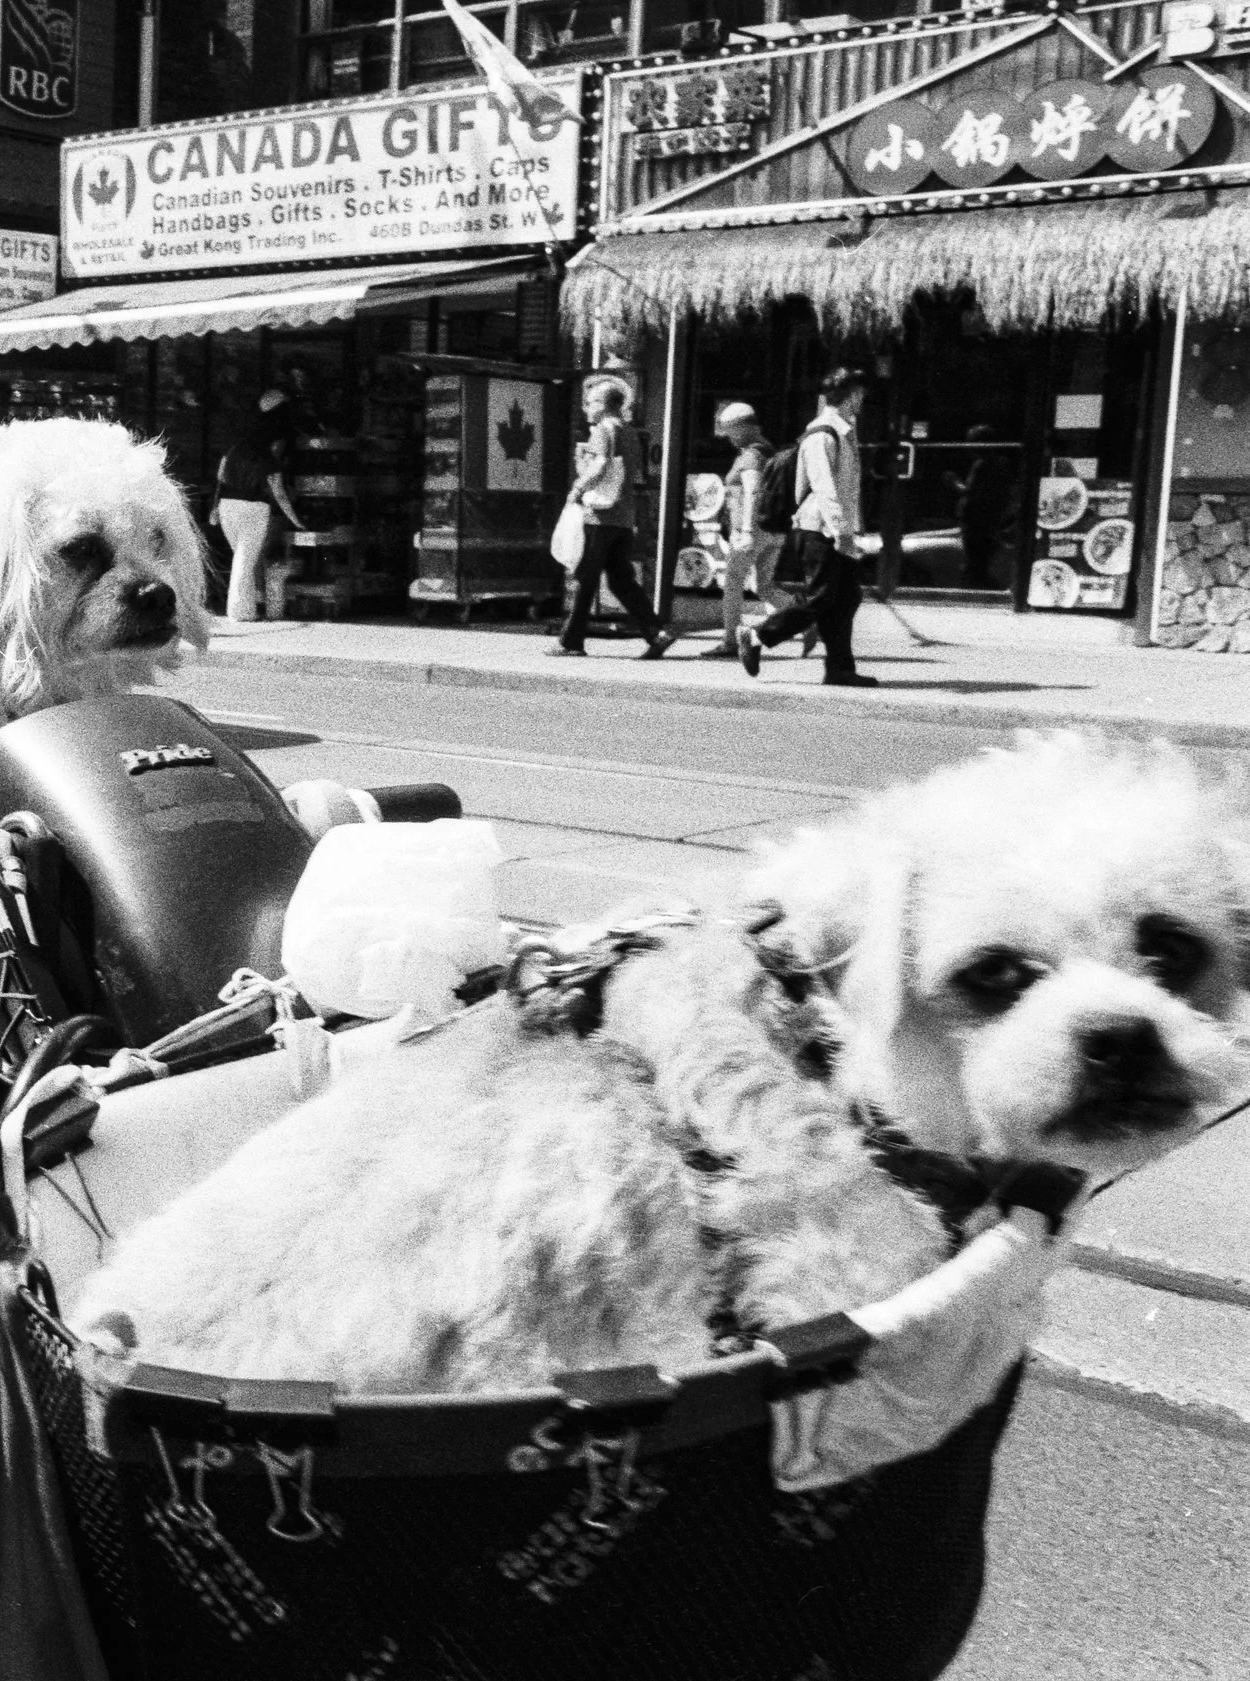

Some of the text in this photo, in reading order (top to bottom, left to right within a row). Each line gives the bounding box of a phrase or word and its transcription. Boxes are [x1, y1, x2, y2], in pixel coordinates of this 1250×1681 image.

[9, 66, 69, 107] RBC
[147, 116, 361, 184] CANADA
[152, 156, 550, 211] Canadian Souvenirs T-Shirts Caps
[152, 183, 550, 235] Handbags Gifts Socks And More
[1, 237, 51, 262] GIFTS
[158, 241, 198, 257] Great
[204, 239, 242, 254] Kong
[247, 232, 306, 250] Trading
[312, 229, 343, 245] Inc.
[419, 215, 483, 236] Dundas
[521, 211, 537, 226] W
[120, 743, 212, 771] Pride
